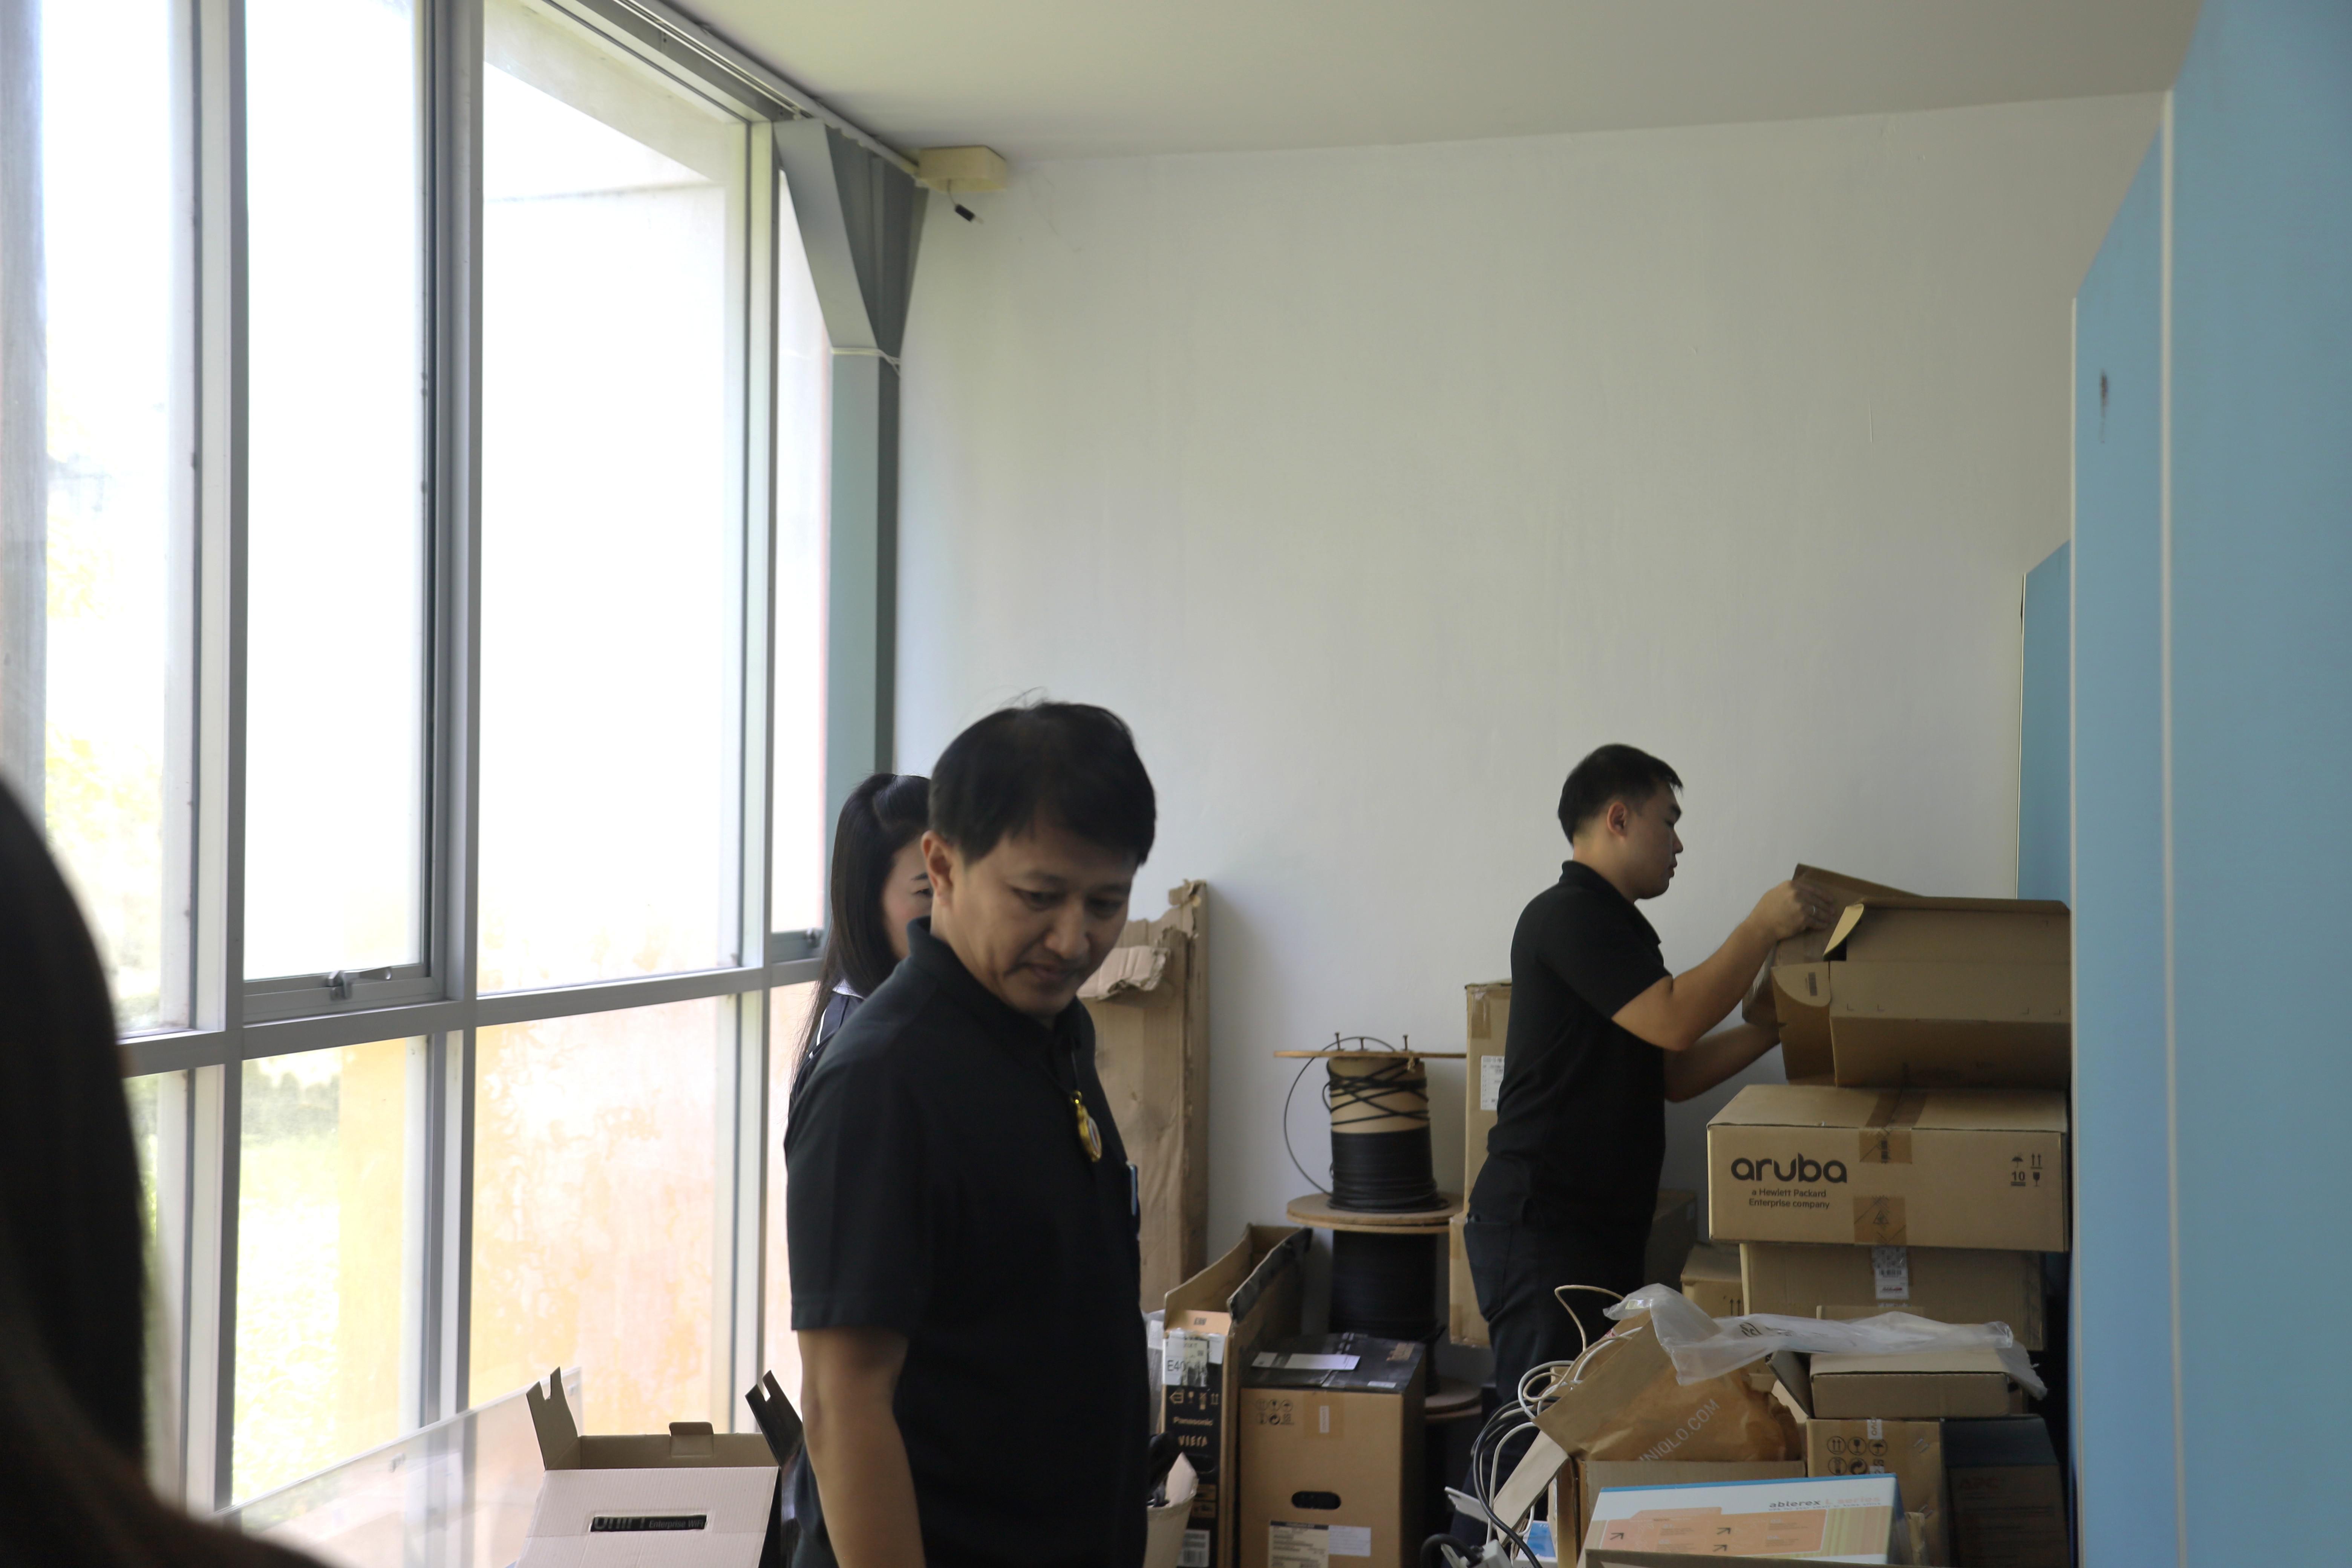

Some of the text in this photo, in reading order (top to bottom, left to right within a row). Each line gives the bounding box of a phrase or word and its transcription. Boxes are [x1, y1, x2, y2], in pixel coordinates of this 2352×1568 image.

[1731, 1152, 1847, 1183] aruba
[2012, 1171, 2025, 1181] 10
[1759, 1188, 1791, 1196] Hewlett
[1794, 1189, 1826, 1197] Packard
[1749, 1198, 1830, 1209] Enterprise company
[1638, 1399, 1720, 1461] NIQLO.COM
[649, 1520, 685, 1529] Enterprise
[688, 1519, 704, 1528] WiFi
